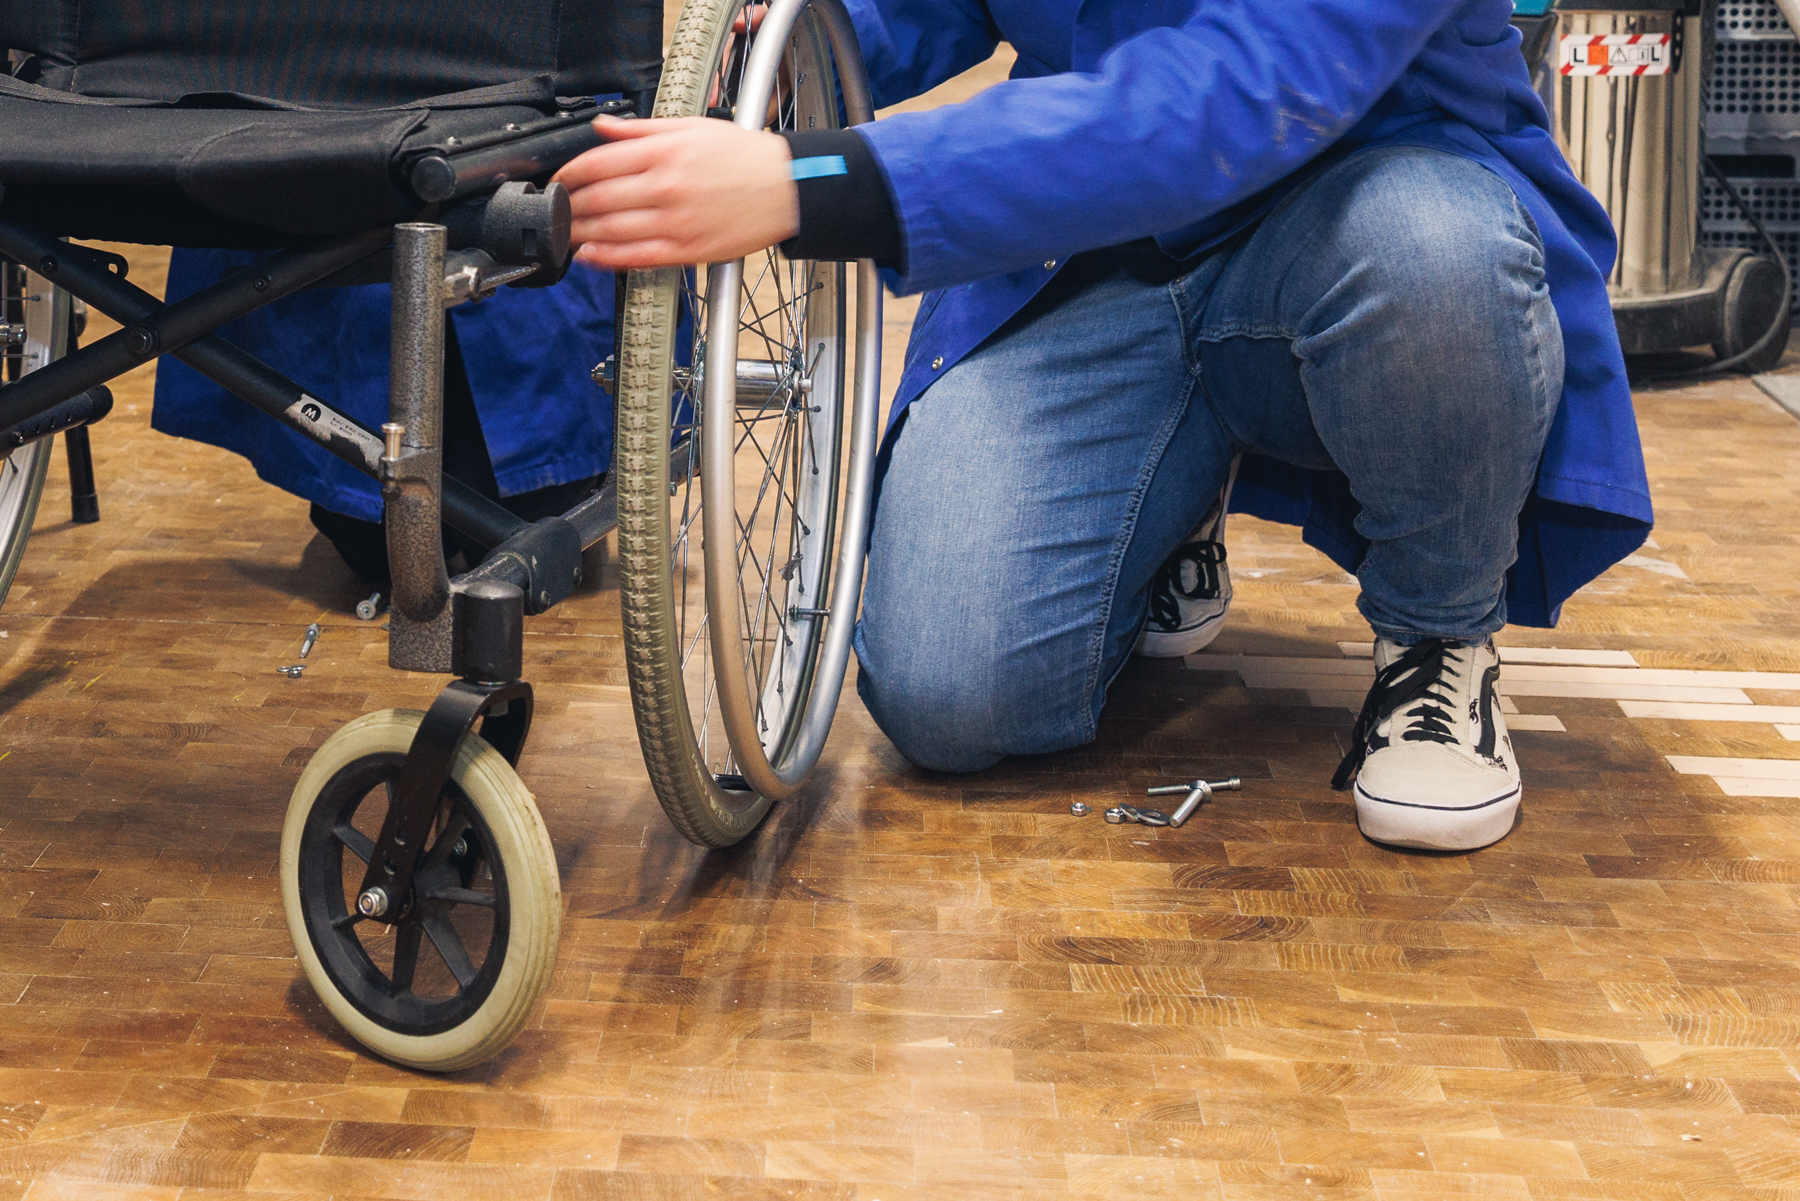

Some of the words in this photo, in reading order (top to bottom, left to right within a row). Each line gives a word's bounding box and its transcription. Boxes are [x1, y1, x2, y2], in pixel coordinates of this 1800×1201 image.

[1573, 47, 1584, 62] L
[1651, 46, 1660, 61] L
[305, 407, 317, 419] M
